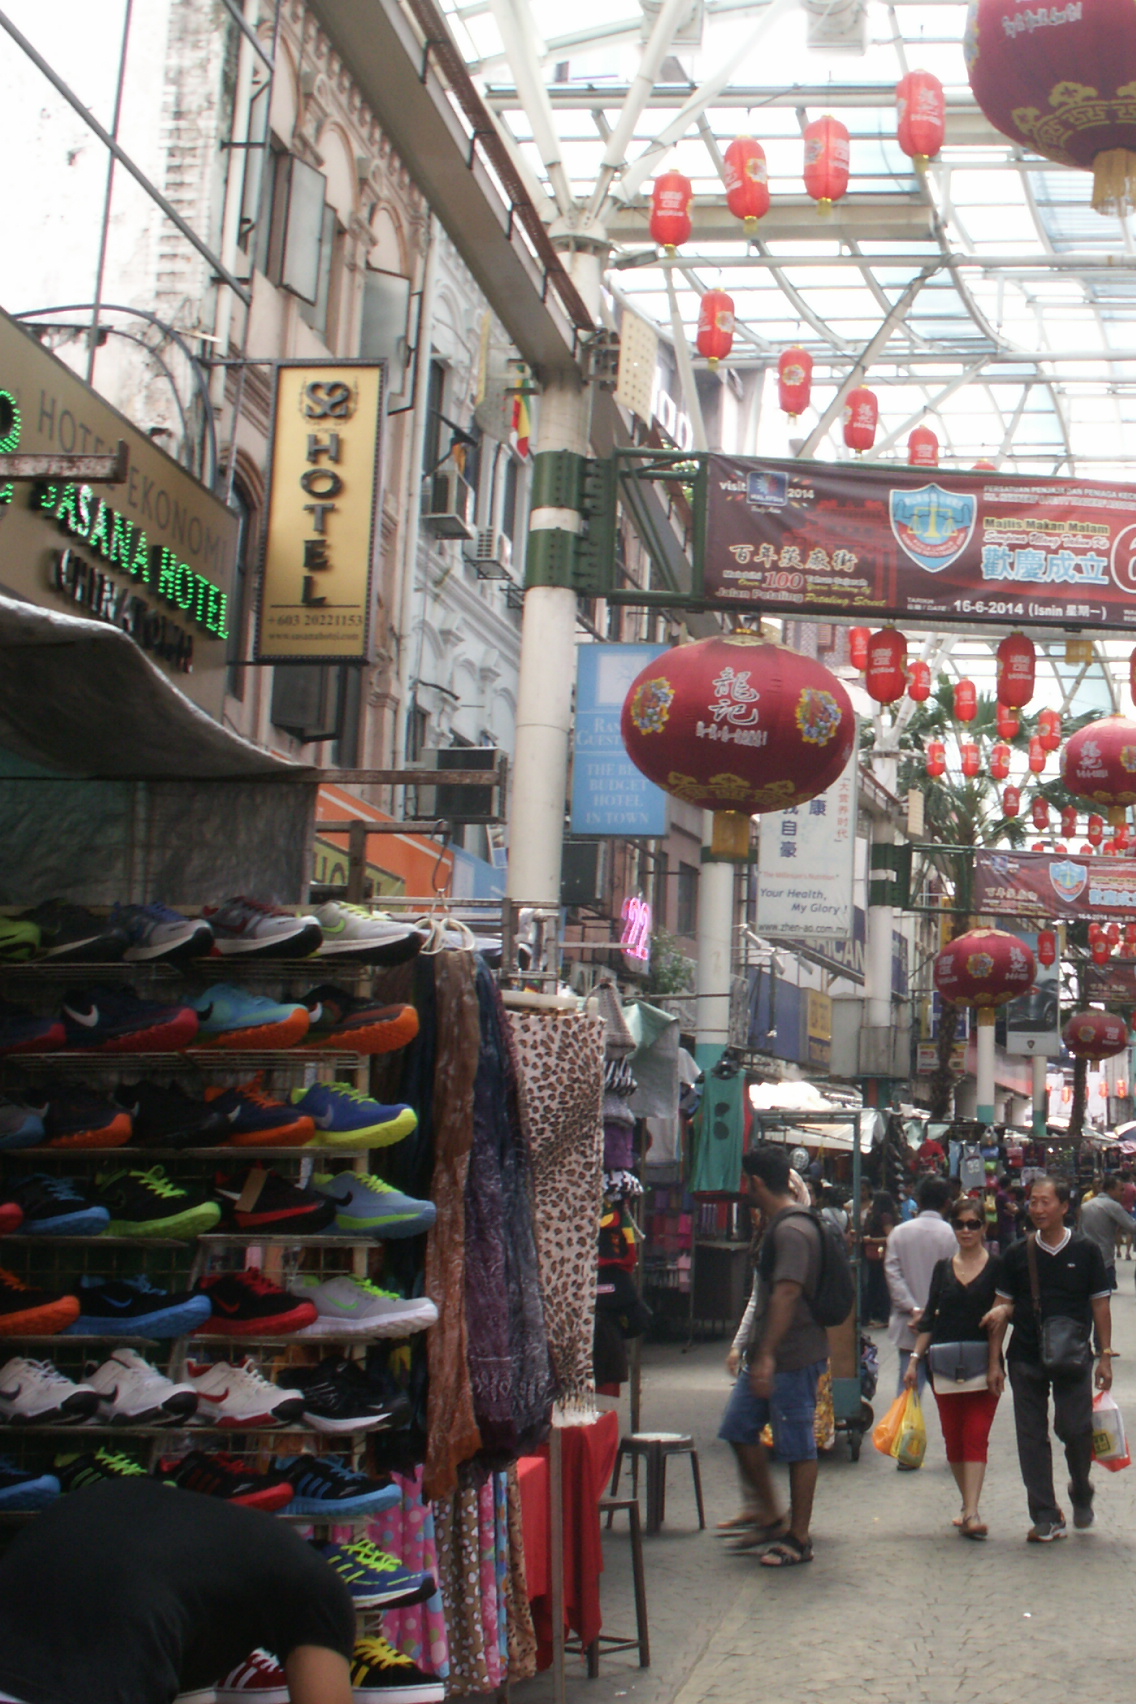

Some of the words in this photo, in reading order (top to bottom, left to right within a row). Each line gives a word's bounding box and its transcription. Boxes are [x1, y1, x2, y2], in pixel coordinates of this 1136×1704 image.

[719, 481, 747, 491] visit
[787, 489, 815, 499] 2014
[127, 464, 230, 574] EKONOMI
[300, 433, 342, 605] HOTEL
[983, 517, 1023, 530] Majlis
[1025, 518, 1065, 532] Makan
[1067, 521, 1110, 535] Malam
[981, 545, 1109, 585] 歡慶成立
[762, 571, 804, 589] 100
[159, 547, 229, 639] HOTEL
[752, 588, 804, 603] Petaling
[953, 600, 1024, 615] 16-6-2014
[268, 616, 299, 626] +603
[304, 615, 363, 627] 20221153
[587, 764, 615, 775] THE
[589, 779, 650, 791] BUDGET
[594, 795, 643, 807] HOTEL
[586, 812, 600, 823] IN
[606, 812, 649, 824] TOWN
[760, 888, 784, 898] Your
[787, 889, 827, 900] Health,
[791, 903, 807, 913] My
[810, 903, 840, 915] Glory
[758, 923, 849, 935] www.zhen-ao.com.my
